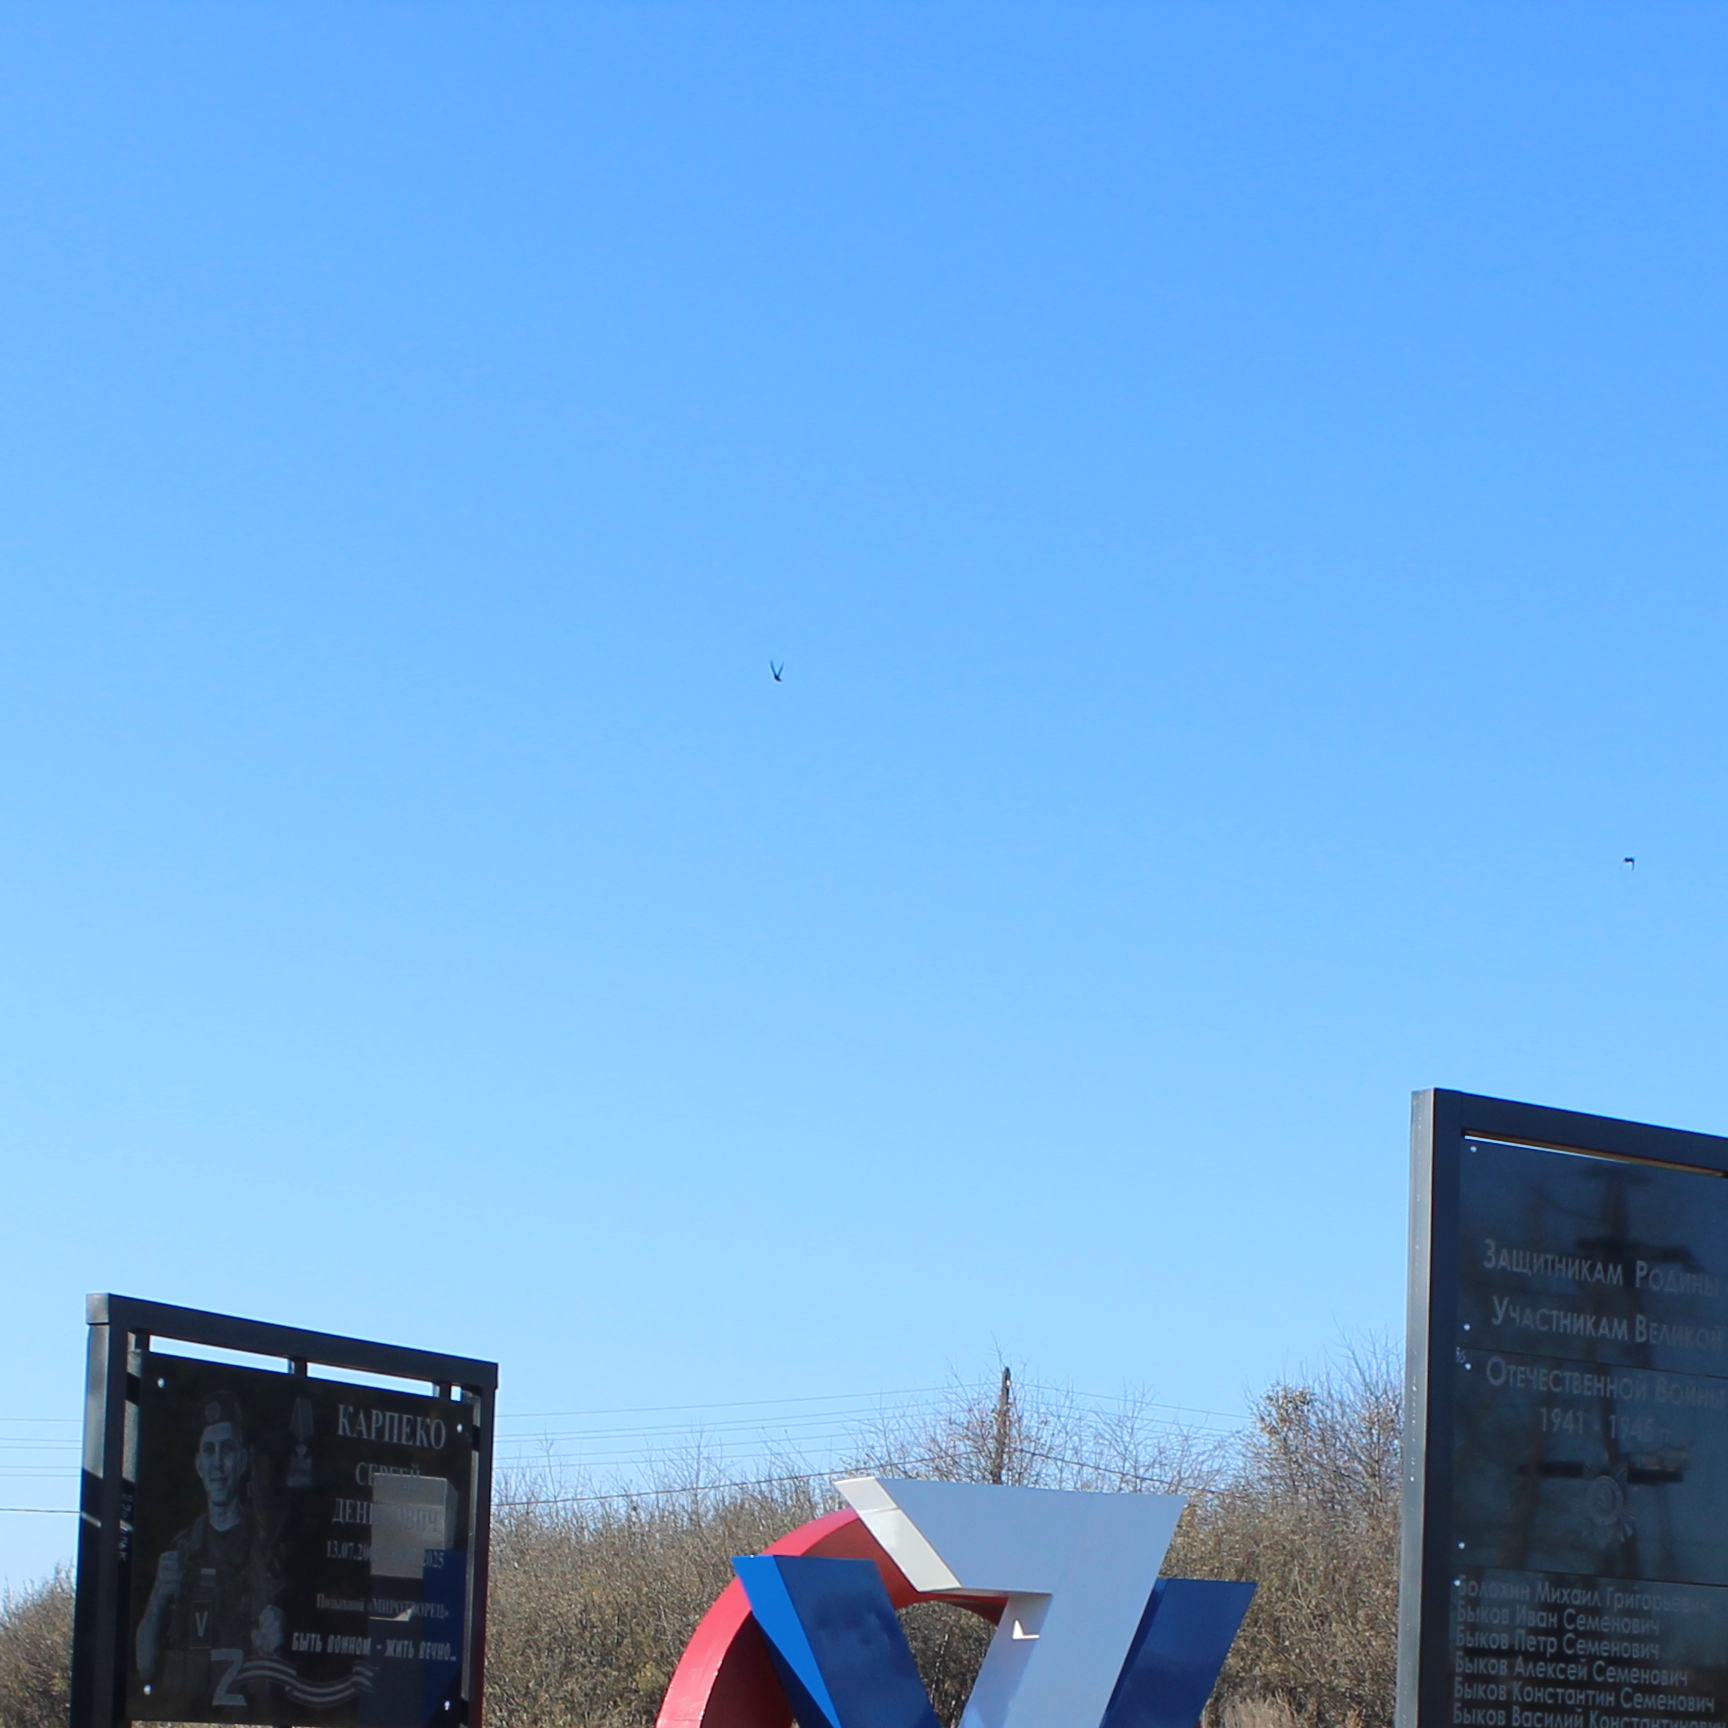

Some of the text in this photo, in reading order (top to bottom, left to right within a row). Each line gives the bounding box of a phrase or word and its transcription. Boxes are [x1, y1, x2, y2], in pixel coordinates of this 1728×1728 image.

[336, 1403, 447, 1451] КАРПЕКО
[1539, 1407, 1584, 1435] 1941
[1609, 1414, 1655, 1443] 1945
[1535, 1581, 1601, 1607] Михаил
[1456, 1600, 1660, 1635] Быков Иван Семенович
[290, 1630, 323, 1653] БЫТЬ
[384, 1637, 415, 1659] ЖИТЬ
[1455, 1626, 1660, 1660] Быков Петр Семенович
[1454, 1651, 1689, 1687] Быков Алексей Семенович
[1453, 1676, 1715, 1713] Быков Константин Семенович
[1452, 1702, 1506, 1726] Быков
